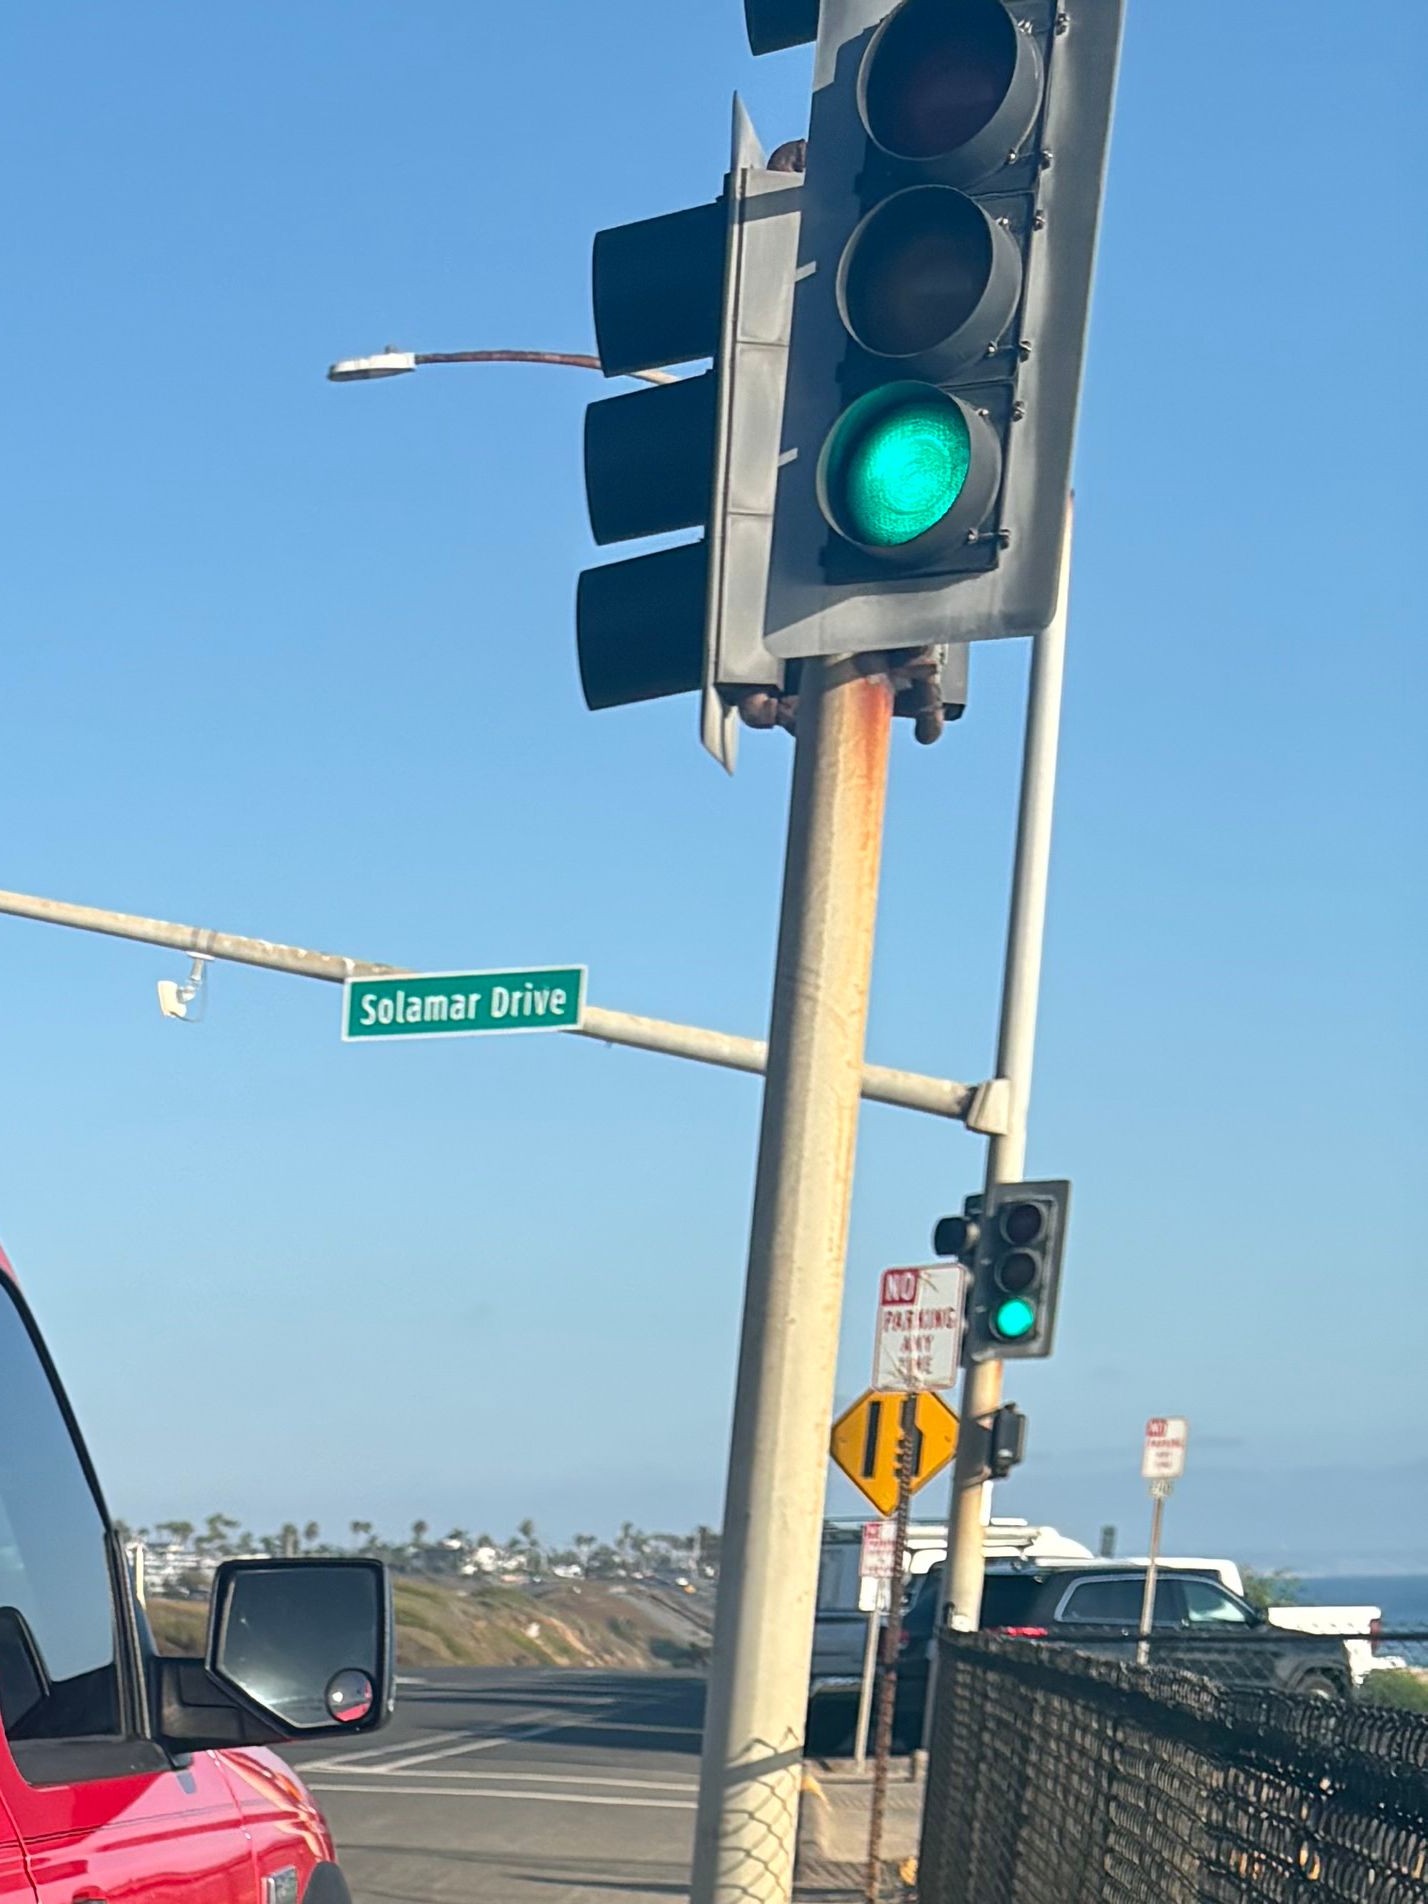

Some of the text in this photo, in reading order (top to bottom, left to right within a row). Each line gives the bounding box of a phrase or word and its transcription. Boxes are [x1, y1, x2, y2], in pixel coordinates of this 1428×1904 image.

[360, 982, 567, 1025] Solamar Drive
[886, 1272, 916, 1301] NO
